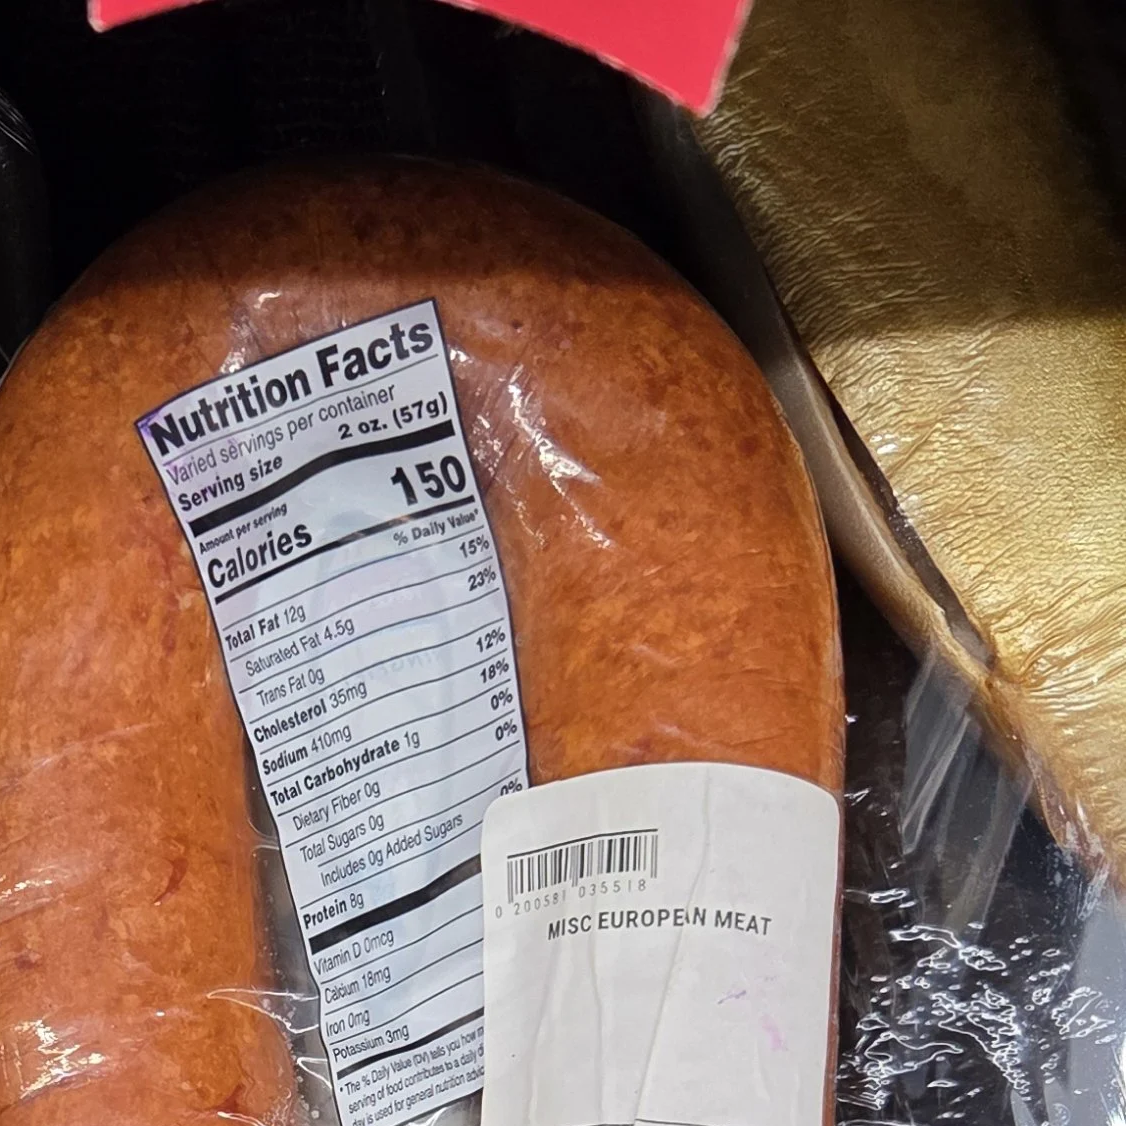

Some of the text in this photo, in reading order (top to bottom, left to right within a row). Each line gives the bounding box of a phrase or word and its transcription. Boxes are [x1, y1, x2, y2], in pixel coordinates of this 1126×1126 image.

[148, 322, 433, 457] Nutrition Facts
[166, 383, 397, 486] Varied servings per container
[178, 392, 448, 512] Serving size 2 oz. (57g)
[199, 502, 287, 554] Amount per serving
[207, 453, 466, 589] Calories 150
[393, 530, 408, 546] %
[412, 519, 446, 542] Daily
[225, 536, 489, 651] Total Fat 12g 15%
[245, 569, 496, 677] Saturated Fat 4.5g 23%
[254, 630, 506, 744] Cholesterol 35mg 12%
[257, 665, 325, 708] Trans Fat 0g
[262, 660, 509, 776] Sodium 410mg 18%
[270, 689, 513, 807] Total Carbohydrate 1g 0%
[292, 720, 517, 831] Dietary Fiber 0g 0%
[299, 812, 385, 863] Total Sugars 0g
[321, 851, 366, 888] Includes
[368, 844, 384, 867] 0g
[385, 827, 422, 858] Added
[423, 812, 463, 843] Sugars
[303, 891, 364, 930] Protein 8g
[548, 908, 772, 940] MISC EUROPEN MEAT
[313, 928, 394, 977] Vitamin D 0mcg
[324, 965, 391, 1005] Calcium 18mg
[326, 1005, 370, 1037] Iron 0mg
[332, 1023, 410, 1062] Potassium 3mg
[371, 1066, 391, 1084] Daily
[392, 1058, 413, 1076] Value
[446, 1040, 460, 1056] you
[461, 1030, 476, 1046] how
[387, 1076, 404, 1096] food
[460, 1046, 477, 1067] daily
[375, 1103, 394, 1121] used
[394, 1095, 405, 1113] for
[406, 1082, 435, 1109] general
[435, 1072, 465, 1097] nutrition
[465, 1064, 485, 1085] advic
